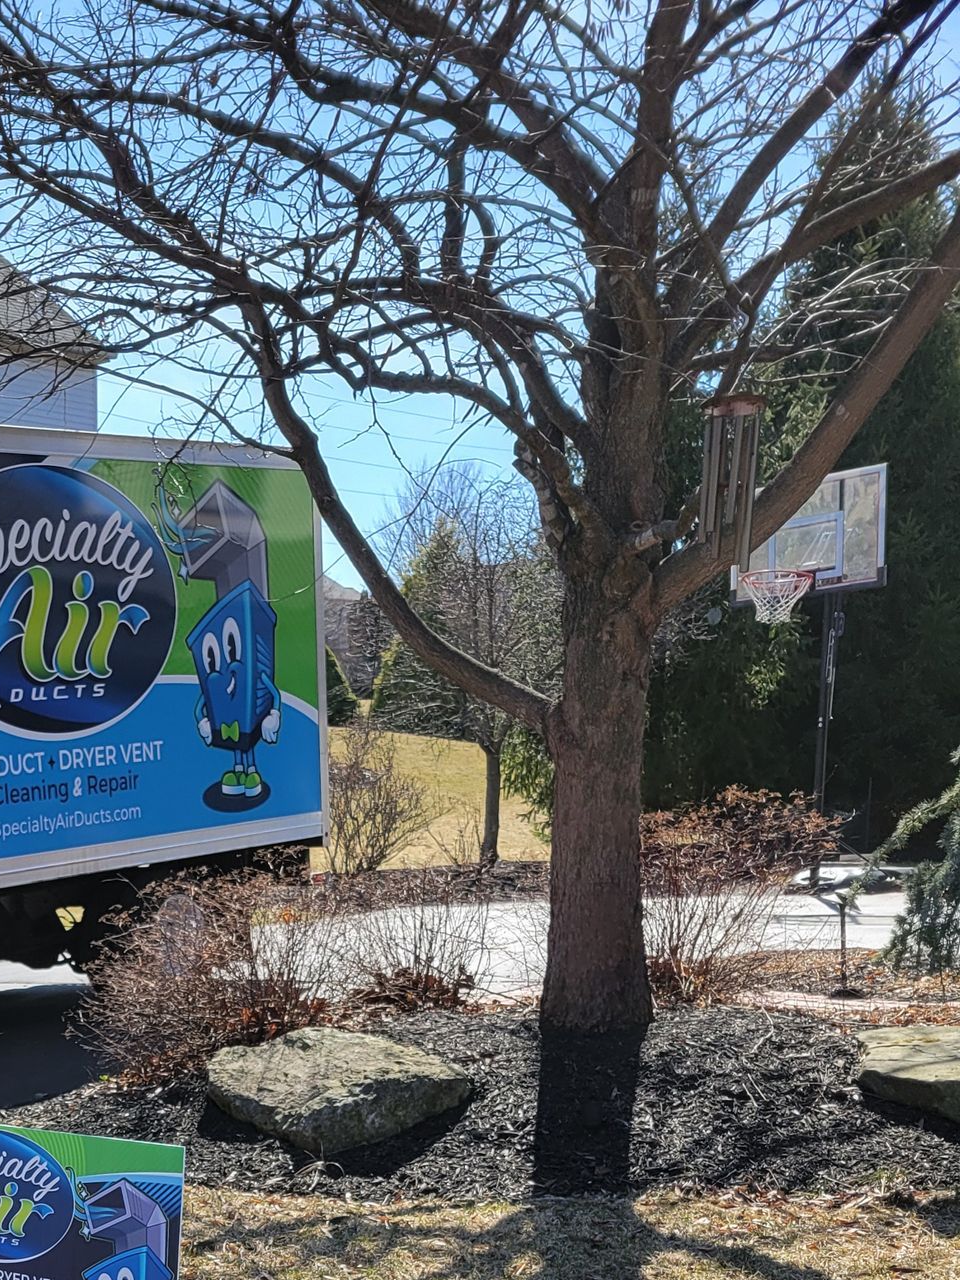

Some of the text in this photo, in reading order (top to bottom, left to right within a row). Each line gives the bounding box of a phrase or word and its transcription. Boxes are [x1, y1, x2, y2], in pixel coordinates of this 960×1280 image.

[10, 683, 105, 702] DUCTS
[59, 745, 117, 771] DRYER
[120, 740, 164, 764] VENT
[72, 776, 83, 798] &
[87, 770, 140, 798] Repair
